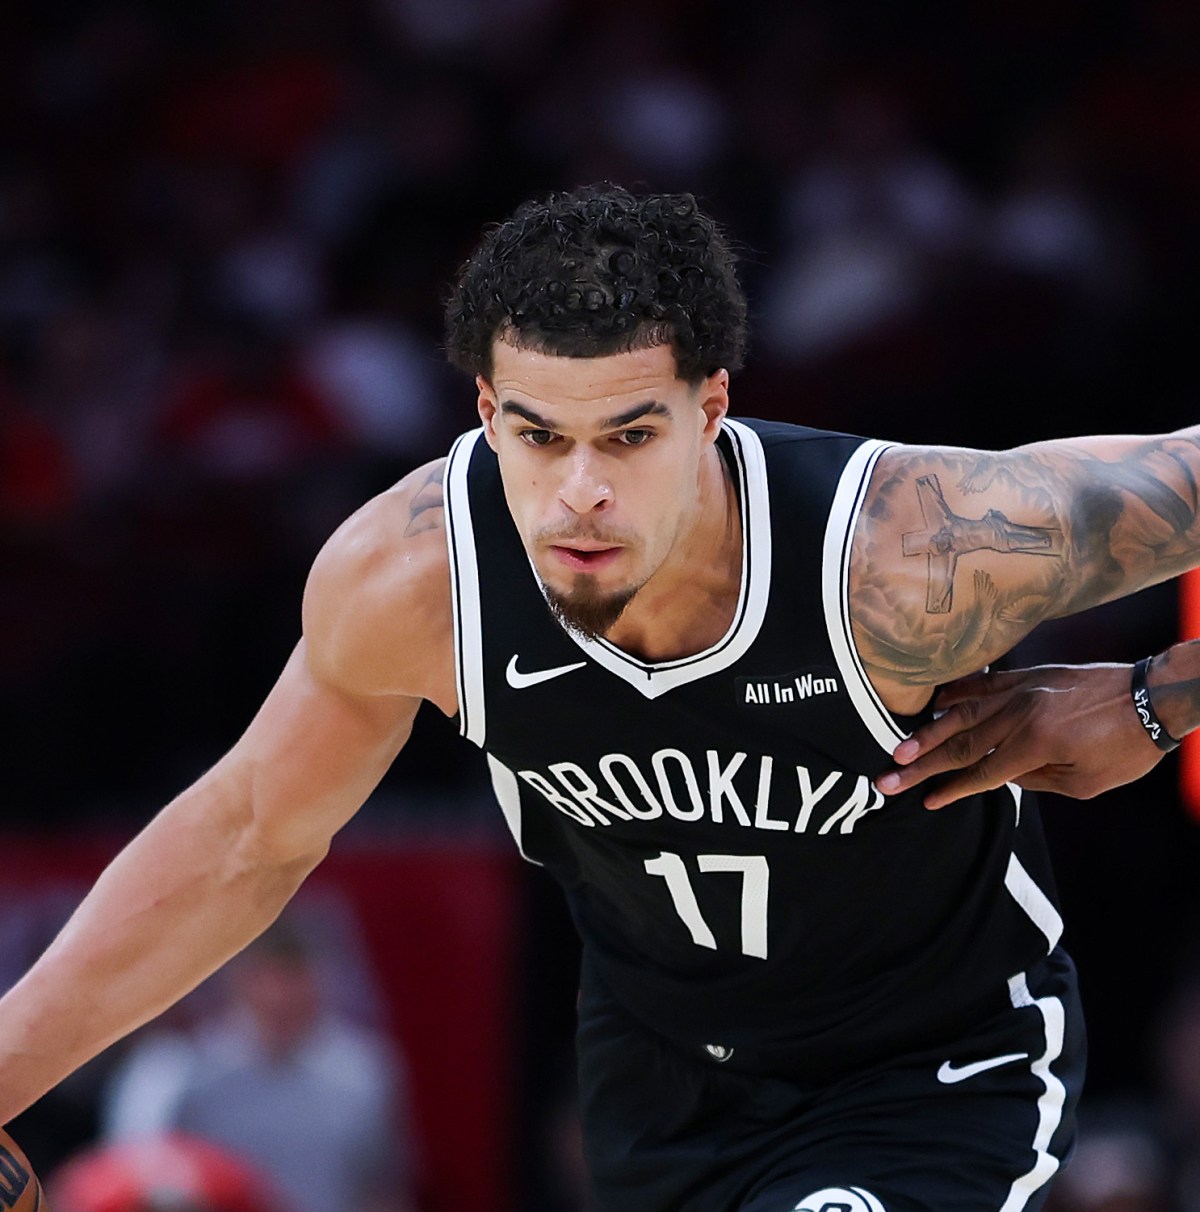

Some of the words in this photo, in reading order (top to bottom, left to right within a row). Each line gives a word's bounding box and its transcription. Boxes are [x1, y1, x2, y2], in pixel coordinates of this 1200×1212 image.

[745, 683, 770, 704] All
[774, 683, 794, 704] In
[795, 673, 838, 700] Won
[518, 748, 885, 835] BROOKLYN
[643, 851, 770, 960] 17
